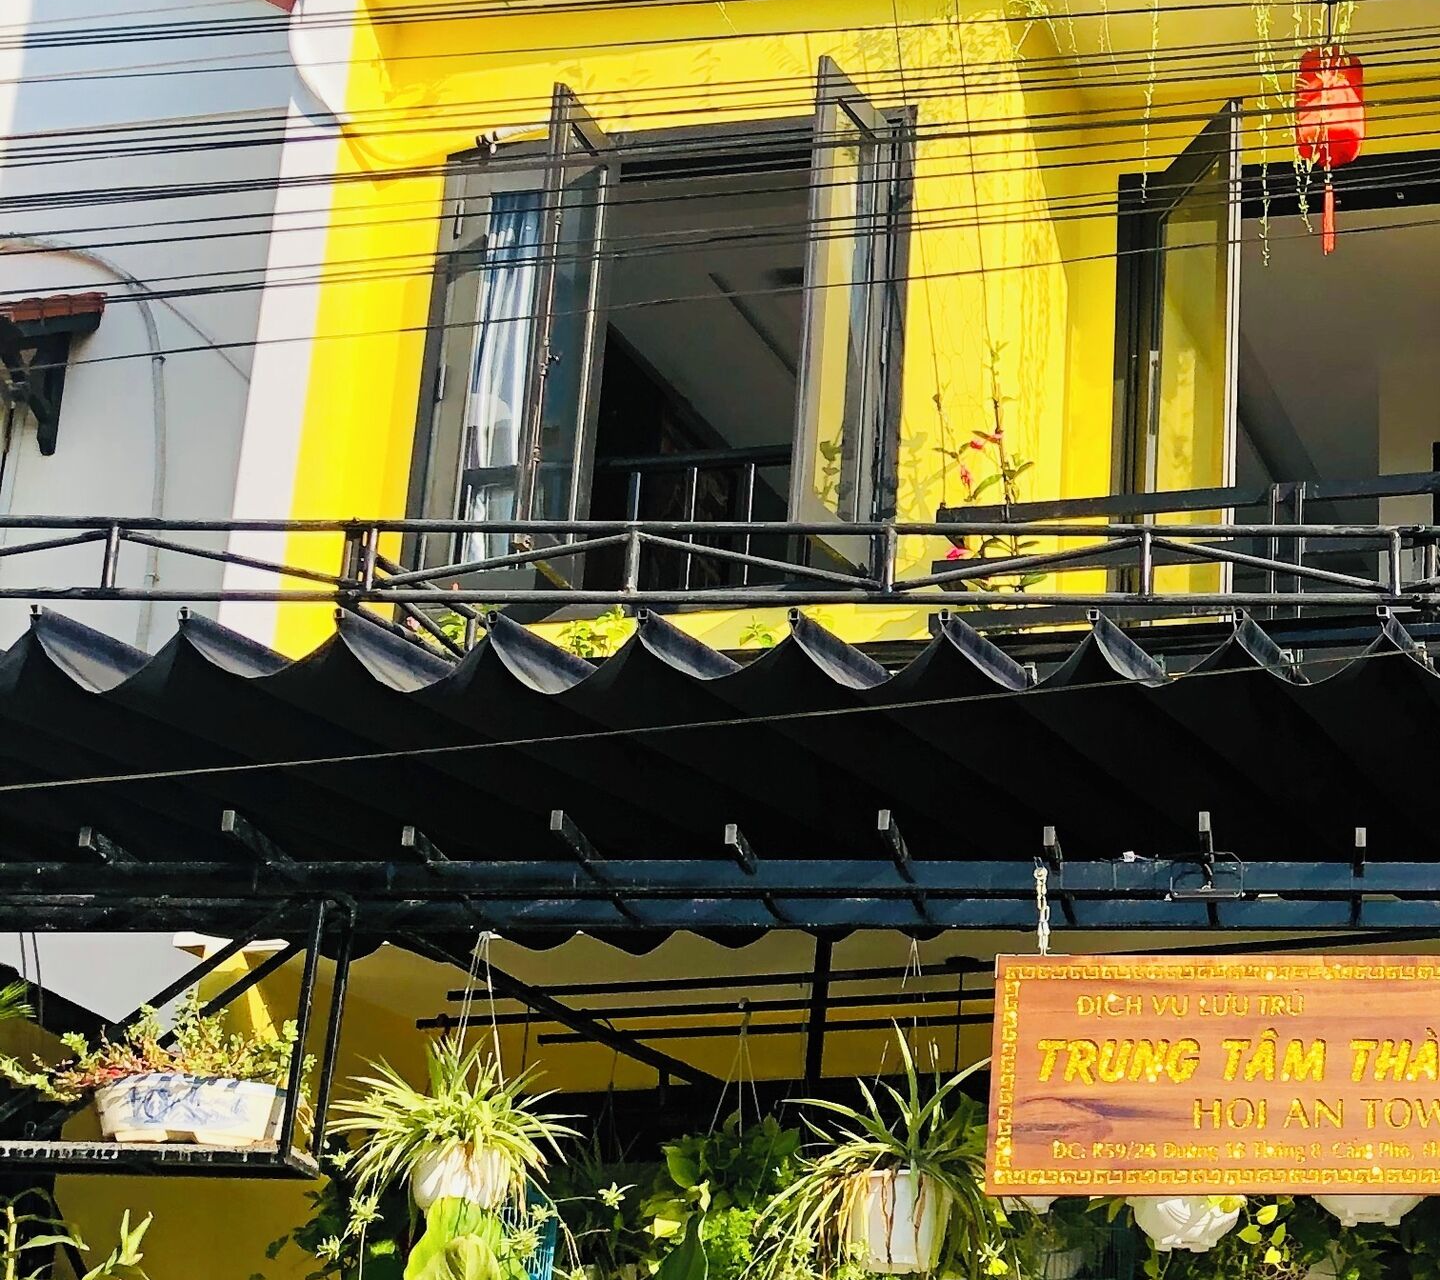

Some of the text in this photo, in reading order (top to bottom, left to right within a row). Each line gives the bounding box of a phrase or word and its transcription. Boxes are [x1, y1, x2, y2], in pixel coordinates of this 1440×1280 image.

[1076, 993, 1142, 1019] DỊCH
[1152, 994, 1190, 1020] VỤ
[1199, 992, 1250, 1016] LƯU
[1036, 1038, 1200, 1085] TRUNG
[1221, 1027, 1327, 1083] TÂM
[1192, 1098, 1269, 1129] HOI
[1284, 1098, 1344, 1129] AN
[1253, 1140, 1306, 1163] Tháng
